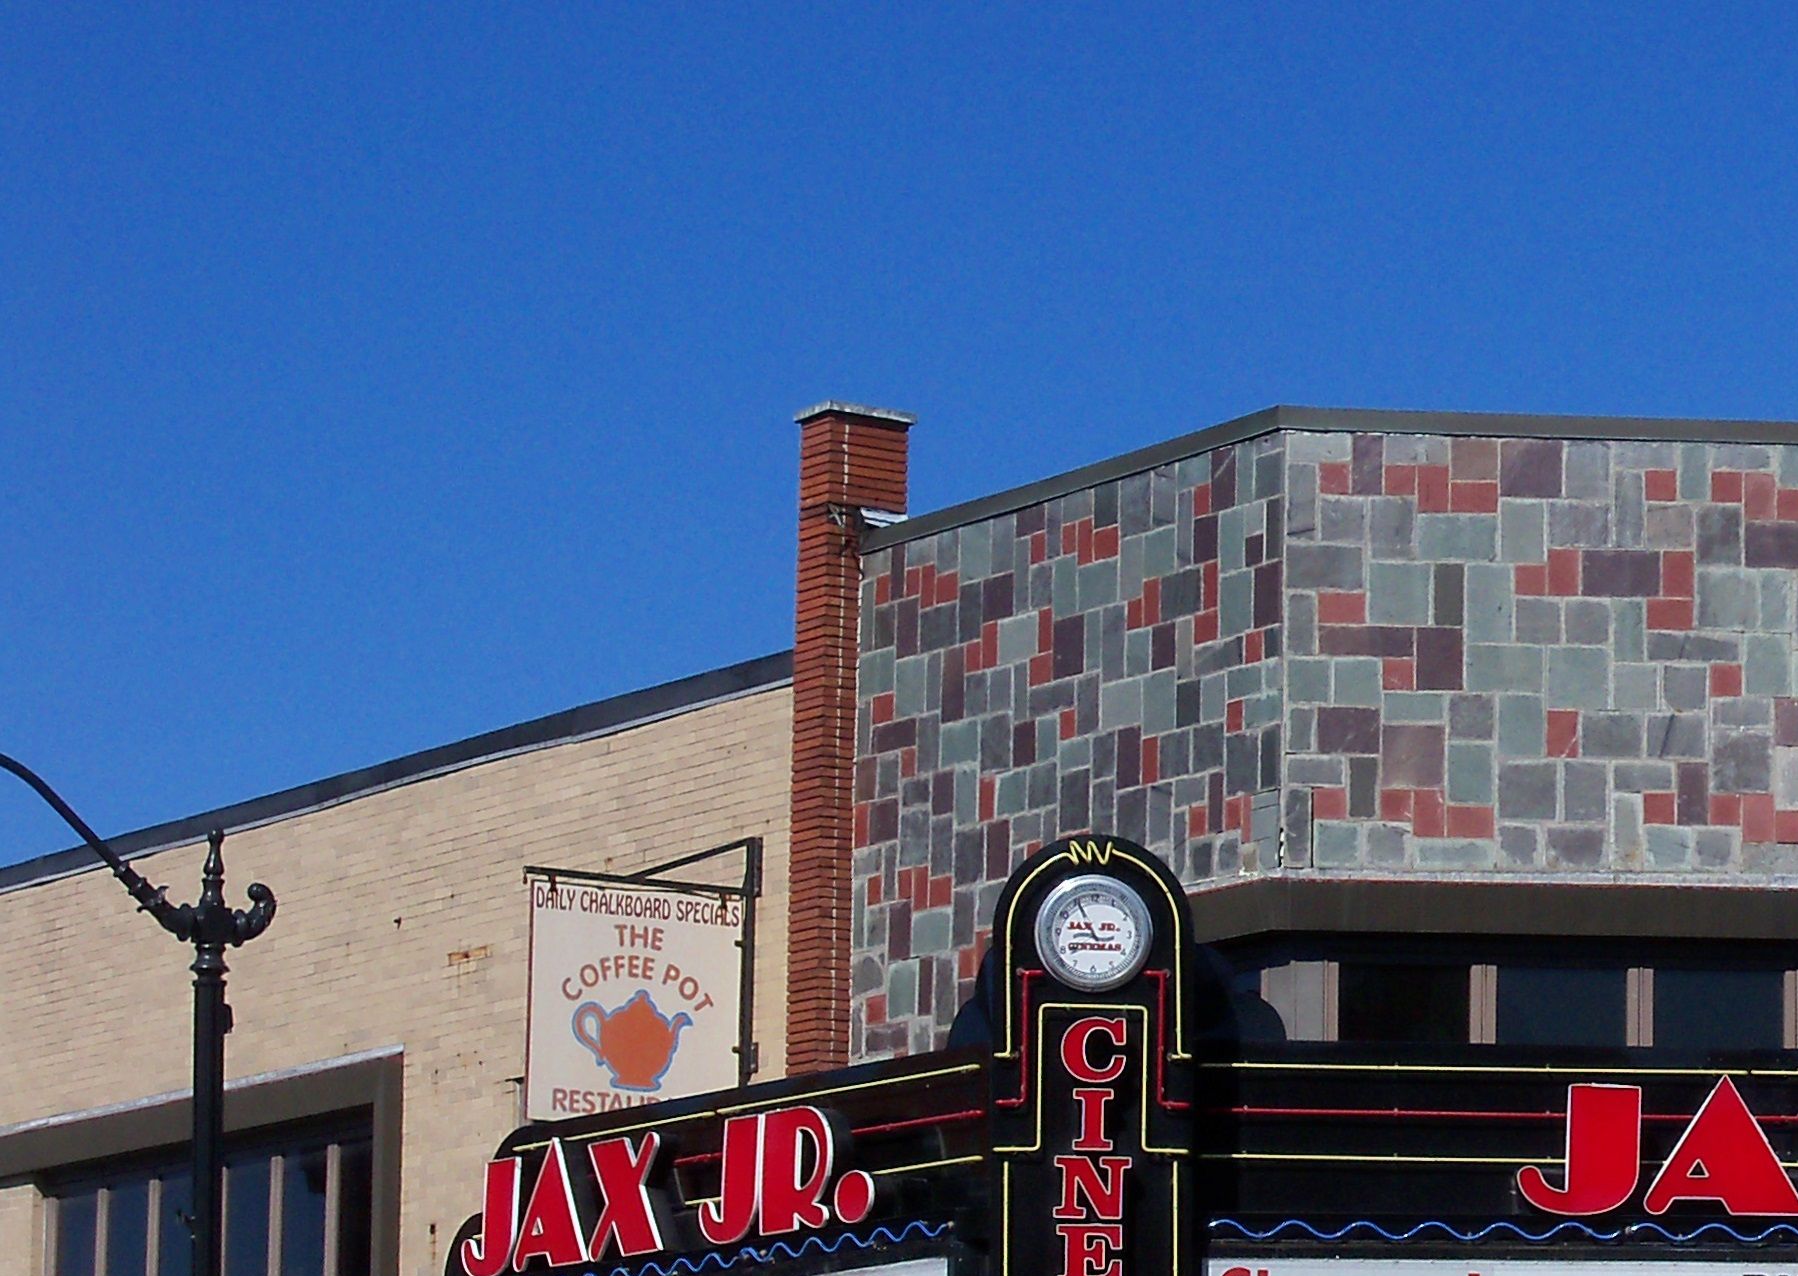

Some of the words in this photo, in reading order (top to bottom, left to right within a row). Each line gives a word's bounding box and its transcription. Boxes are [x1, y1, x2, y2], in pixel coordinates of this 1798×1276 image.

[536, 886, 576, 910] DAILY
[580, 891, 671, 921] CHALKBOARD
[676, 901, 740, 927] SPECIALS
[615, 924, 664, 951] THE
[1067, 922, 1092, 931] JAX
[1098, 922, 1121, 932] JR.
[1068, 942, 1122, 951] CINEMAS
[562, 955, 655, 1002] COFFEE
[661, 963, 714, 1012] POT
[699, 1106, 876, 1244] JR.
